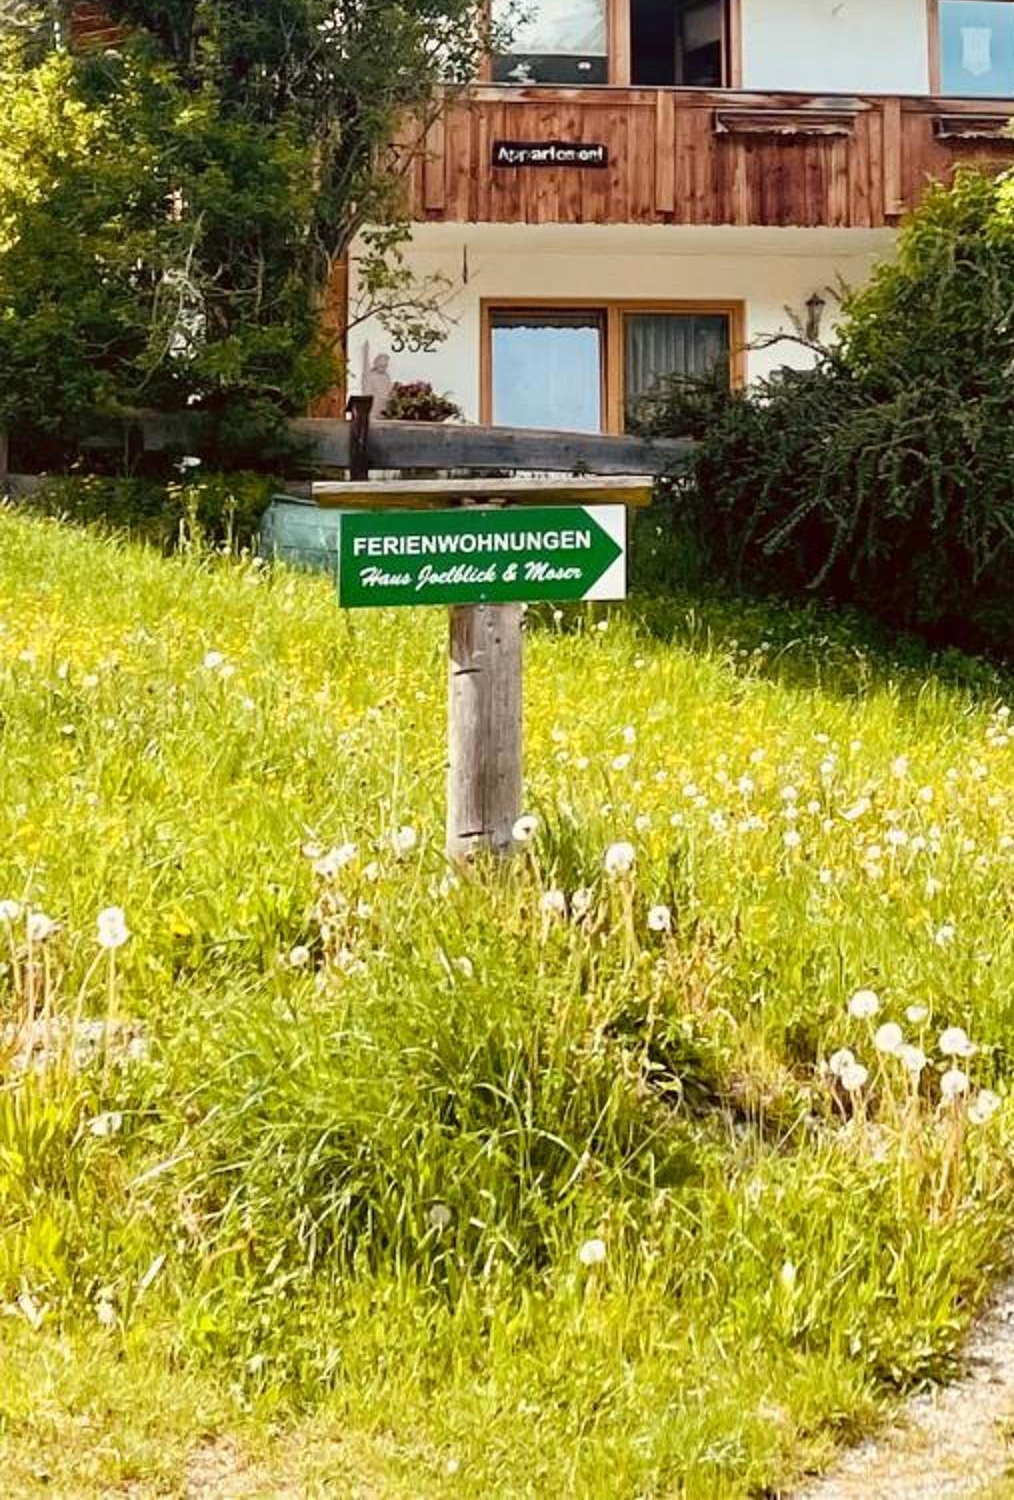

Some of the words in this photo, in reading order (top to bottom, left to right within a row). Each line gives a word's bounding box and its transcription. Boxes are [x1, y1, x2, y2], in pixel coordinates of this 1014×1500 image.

[353, 530, 591, 556] FERIENWOHNUNGEN
[359, 566, 412, 587] Haus
[502, 562, 518, 582] &
[524, 561, 583, 582] Moser
